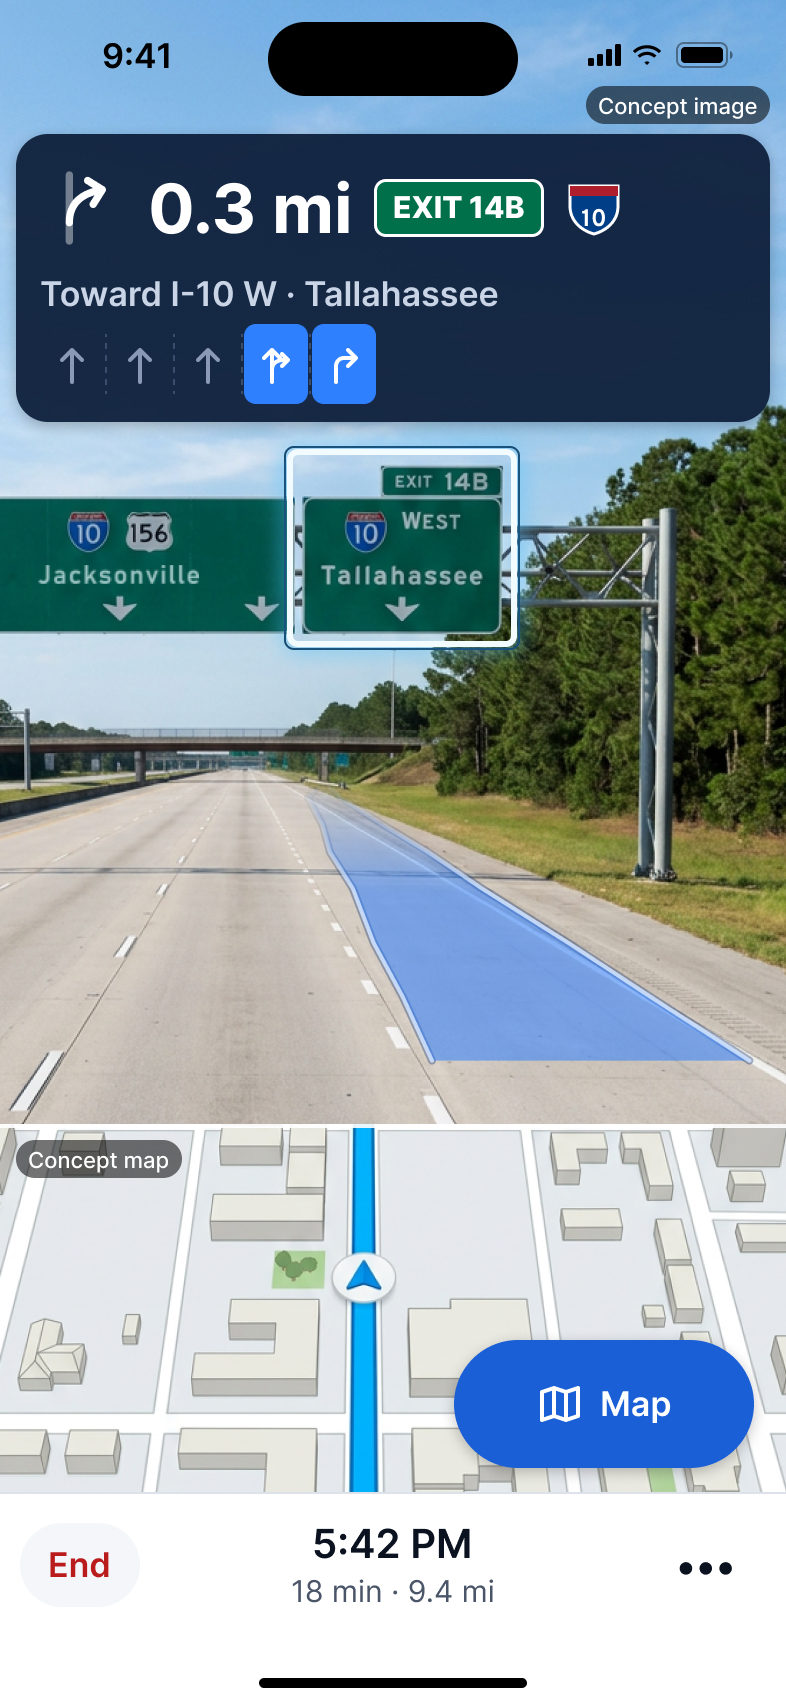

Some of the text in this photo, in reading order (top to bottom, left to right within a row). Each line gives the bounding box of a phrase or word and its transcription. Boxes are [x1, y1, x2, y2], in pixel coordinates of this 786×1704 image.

[103, 42, 171, 69] 9:41
[149, 180, 351, 236] 0.3 mi
[393, 195, 525, 220] EXIT 14B
[580, 208, 607, 228] 10
[40, 280, 161, 307] Toward
[171, 280, 235, 308] I-10
[243, 280, 277, 307] W
[304, 280, 499, 308] Tallahassee
[394, 472, 489, 491] EXIT 14B
[401, 511, 461, 530] WEST
[76, 523, 102, 545] 10
[130, 523, 169, 543] 156
[353, 523, 379, 545] 10
[38, 564, 201, 586] Jacksonville
[320, 564, 484, 586] Tallahassee
[601, 1390, 672, 1424] Map
[313, 1527, 472, 1560] 5:42 PM
[49, 1550, 111, 1579] End
[292, 1579, 323, 1604] 18
[333, 1578, 382, 1603] min
[409, 1579, 453, 1604] 9.4
[463, 1578, 494, 1603] mi
